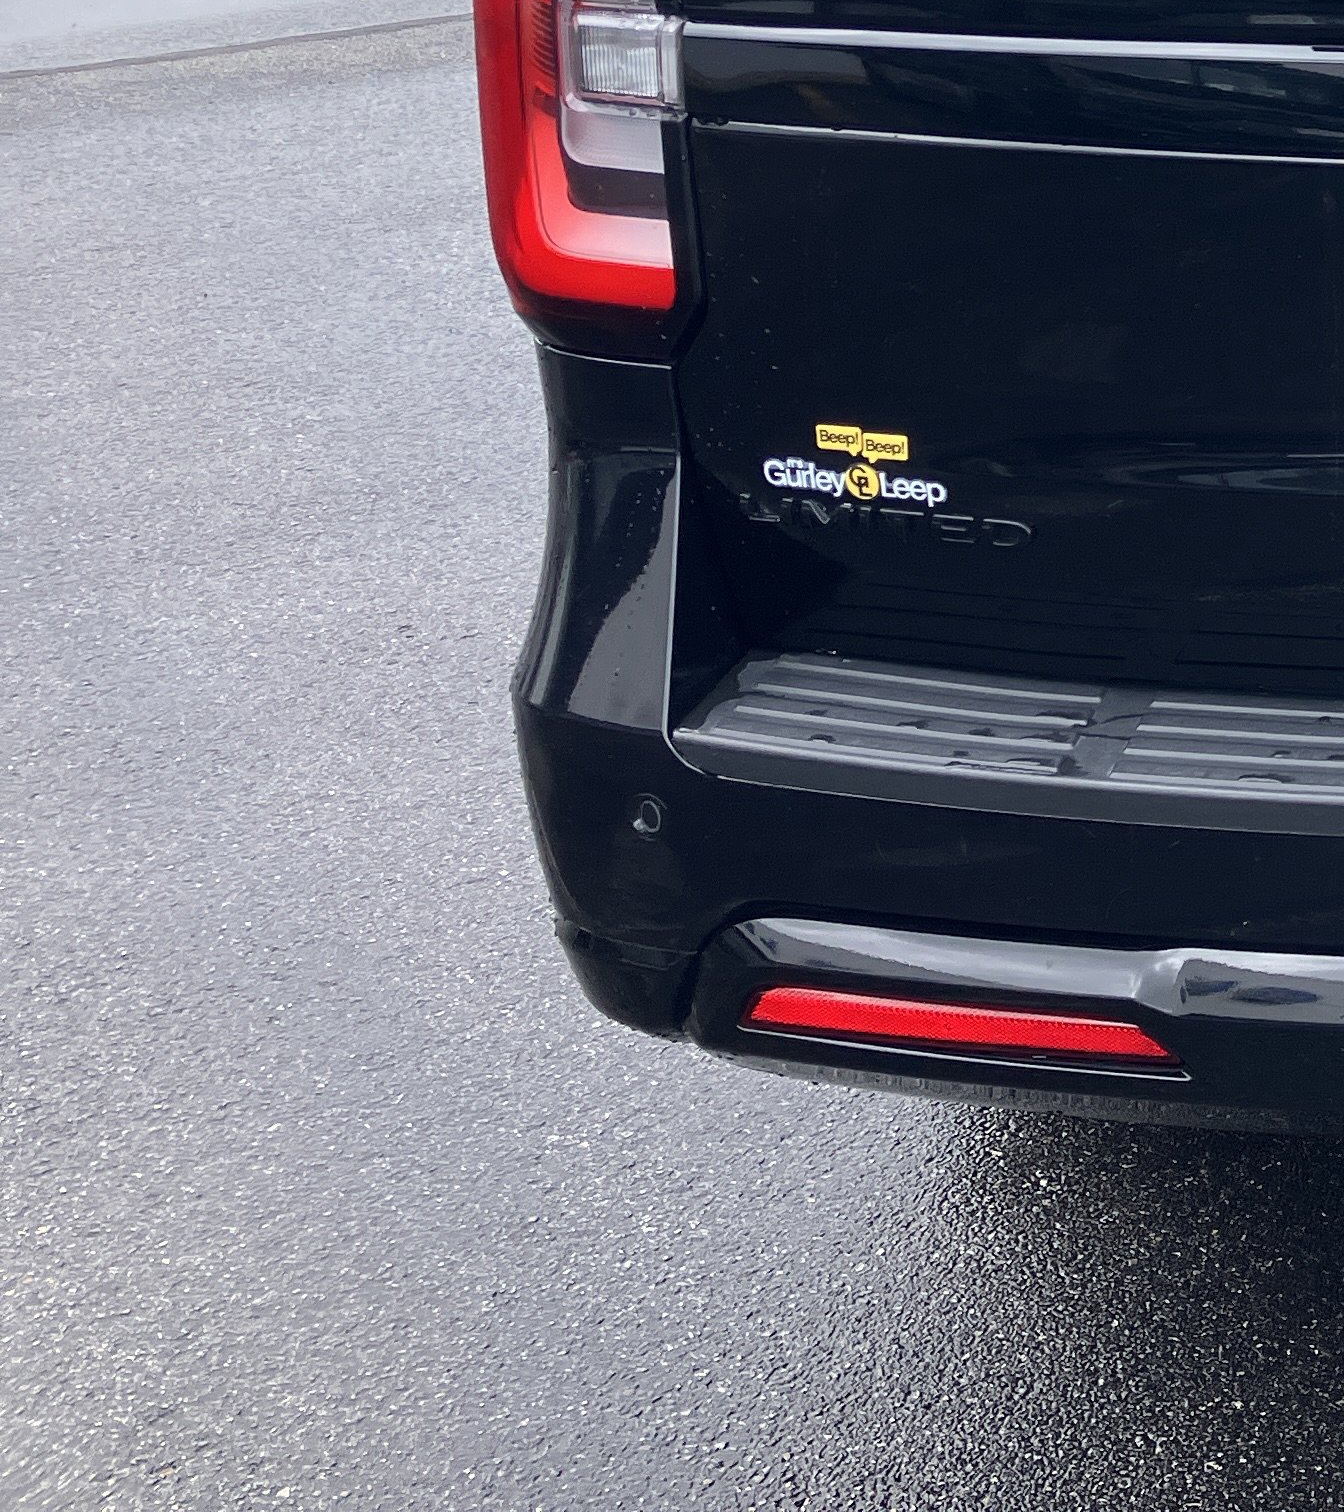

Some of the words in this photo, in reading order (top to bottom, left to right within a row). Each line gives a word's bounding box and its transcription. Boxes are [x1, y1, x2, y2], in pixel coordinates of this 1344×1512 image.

[819, 429, 858, 447] Beep!
[865, 439, 904, 456] Beep!
[763, 459, 846, 497] Gurley
[878, 472, 947, 507] Leep
